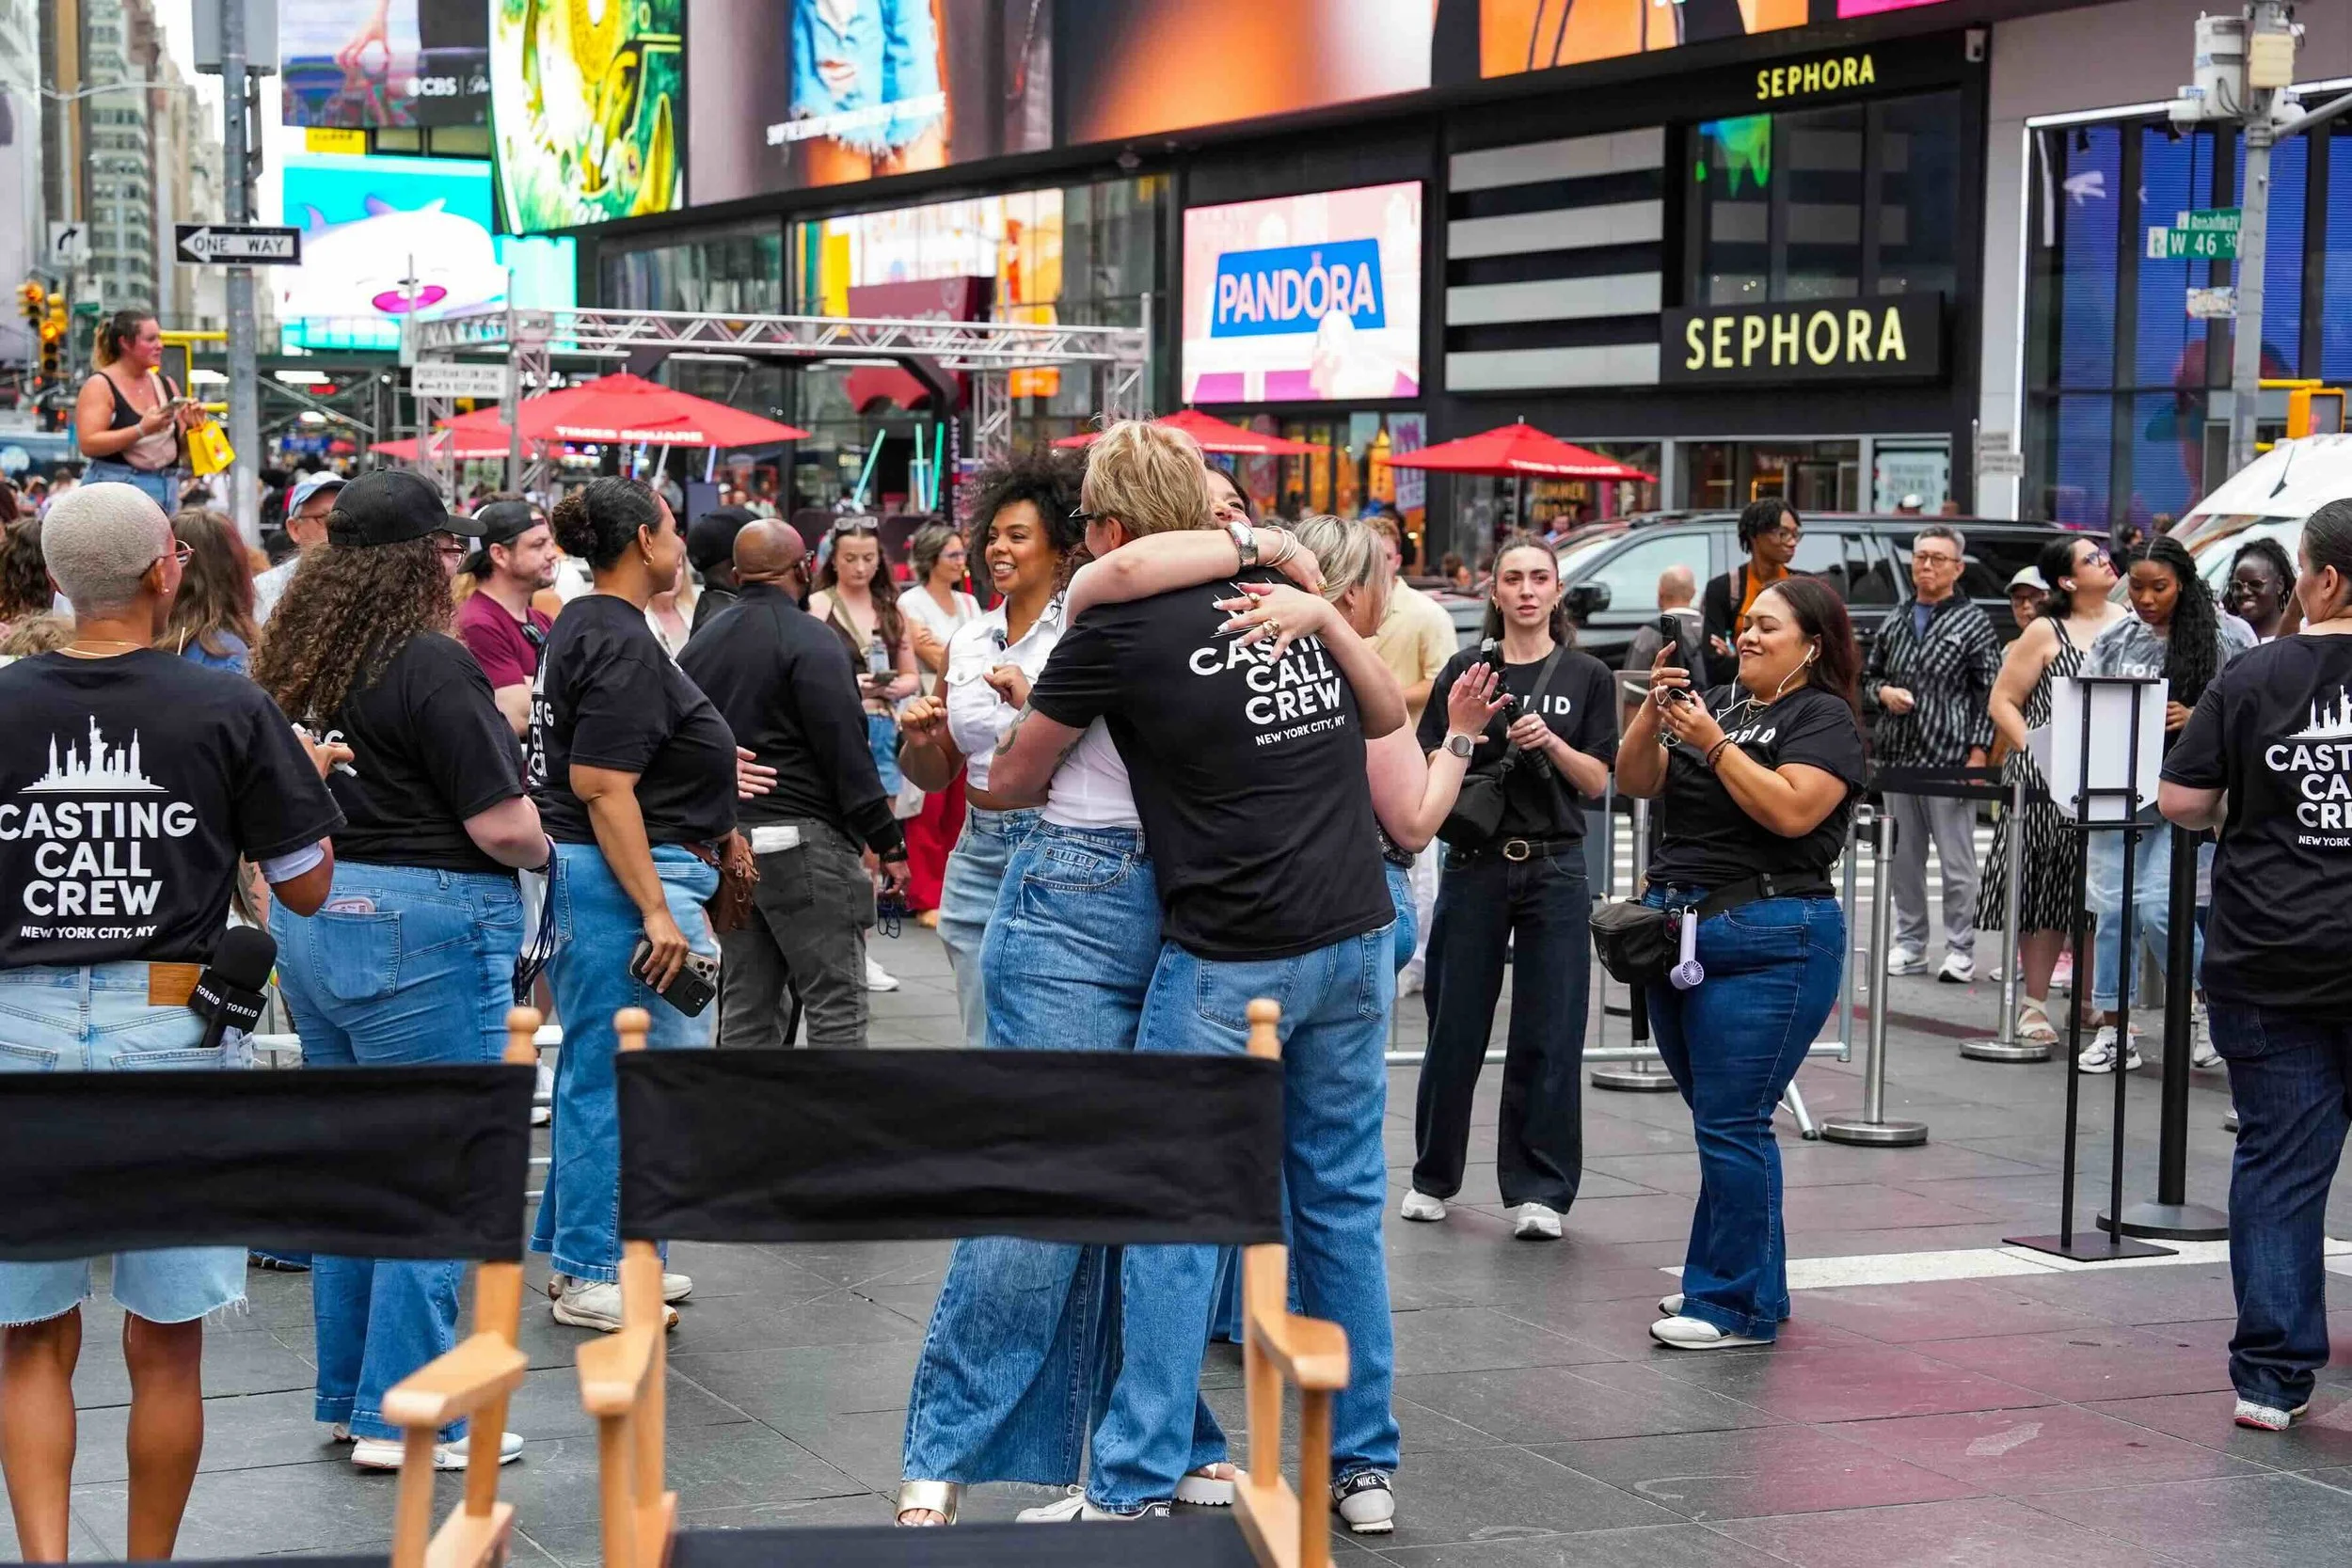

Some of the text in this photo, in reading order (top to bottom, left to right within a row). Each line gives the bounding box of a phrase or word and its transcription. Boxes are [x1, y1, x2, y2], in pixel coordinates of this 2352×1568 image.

[421, 76, 457, 96] CBS
[1756, 55, 1876, 100] SEPHORA
[194, 237, 283, 252] ONE WAY
[2170, 232, 2186, 255] W
[2195, 232, 2217, 255] 46
[1219, 260, 1376, 325] PANDORA
[1685, 307, 1907, 370] SEPHORA
[1246, 651, 1333, 692] CALL
[2122, 663, 2160, 678] TOR
[1245, 678, 1341, 725] CREW
[1255, 715, 1345, 746] NEW YORK CITY, NY
[0, 801, 197, 840] CASTING
[2298, 835, 2350, 847] NEW YORK
[35, 841, 151, 878] CALL
[23, 879, 163, 916] CREW
[21, 926, 157, 940] NEW YORK CITY, NY
[196, 984, 221, 1006] TORRID
[227, 1003, 258, 1018] TORRID
[1357, 1476, 1377, 1487] NIKE
[1154, 1507, 1170, 1518] NIKE
